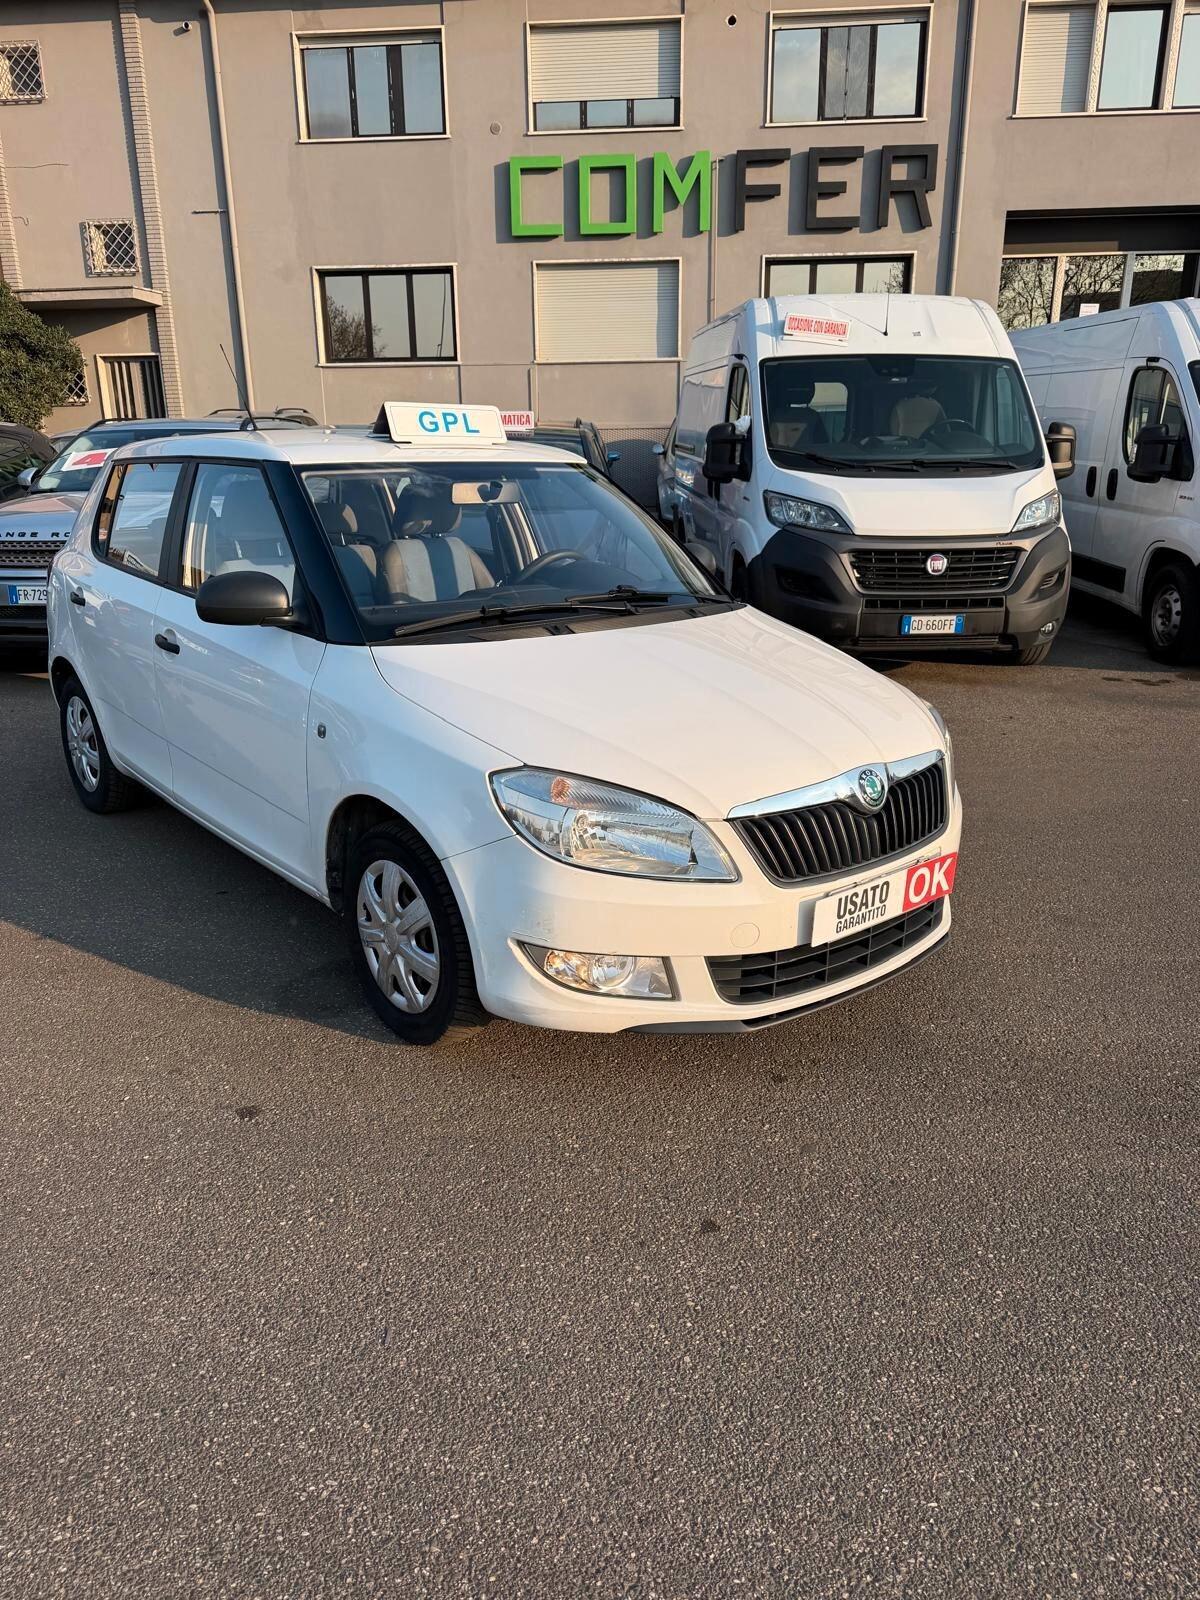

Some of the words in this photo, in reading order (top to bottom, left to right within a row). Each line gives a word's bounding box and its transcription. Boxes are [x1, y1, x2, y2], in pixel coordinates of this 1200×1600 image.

[510, 144, 938, 237] COMFER
[788, 316, 813, 333] OCCASIONE
[813, 319, 824, 334] CON
[824, 321, 847, 336] GARANZIA
[418, 410, 480, 434] GPL
[908, 857, 954, 905] OK
[837, 880, 890, 920] USATO
[835, 904, 887, 934] GARANTITO
